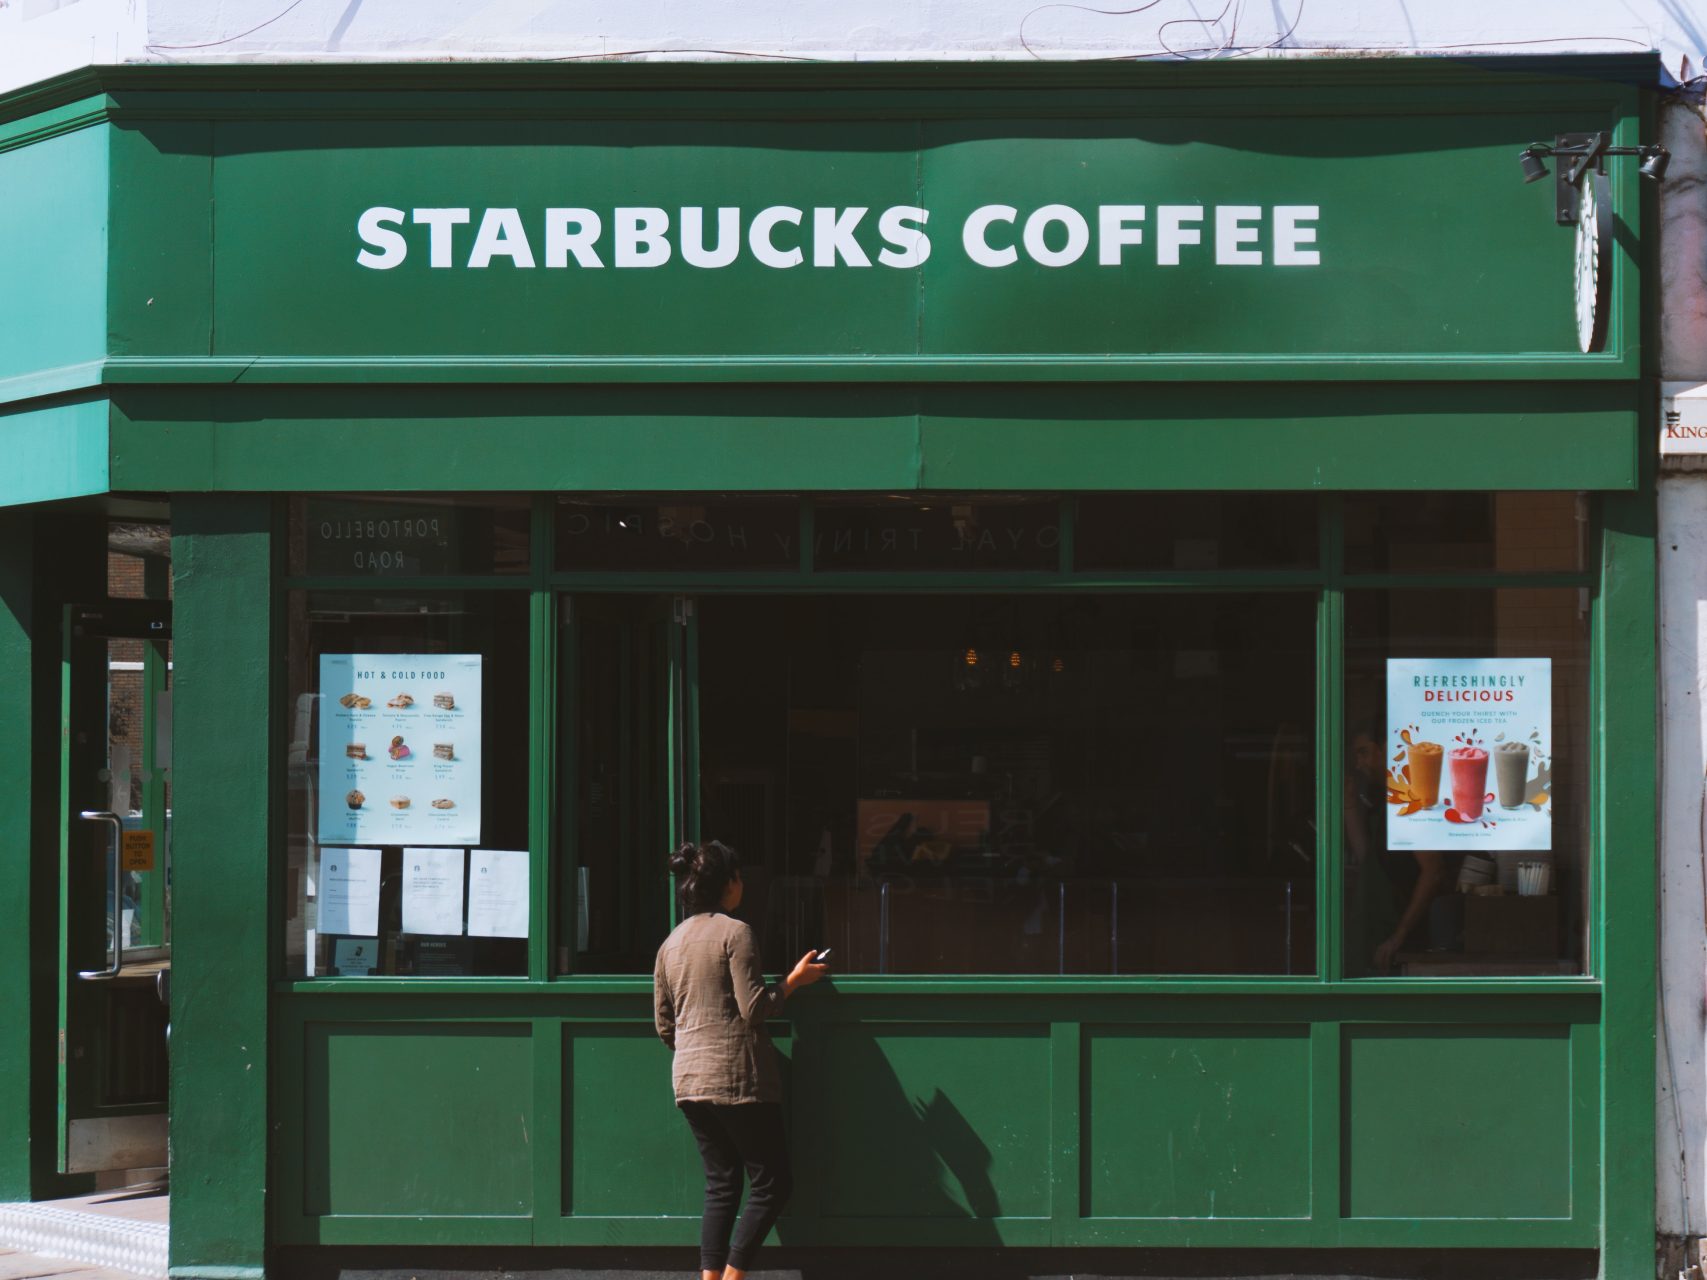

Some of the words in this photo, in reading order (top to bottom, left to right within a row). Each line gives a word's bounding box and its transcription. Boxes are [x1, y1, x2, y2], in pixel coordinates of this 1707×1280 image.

[356, 205, 932, 269] STARBUCKS
[962, 204, 1321, 267] COFFEE
[357, 671, 376, 680] HOT
[380, 671, 387, 680] &
[391, 671, 416, 680] COLD
[421, 671, 446, 680] FOOD
[1413, 675, 1526, 687] REFRESHINGLY
[1424, 690, 1515, 702] DELICIOUS
